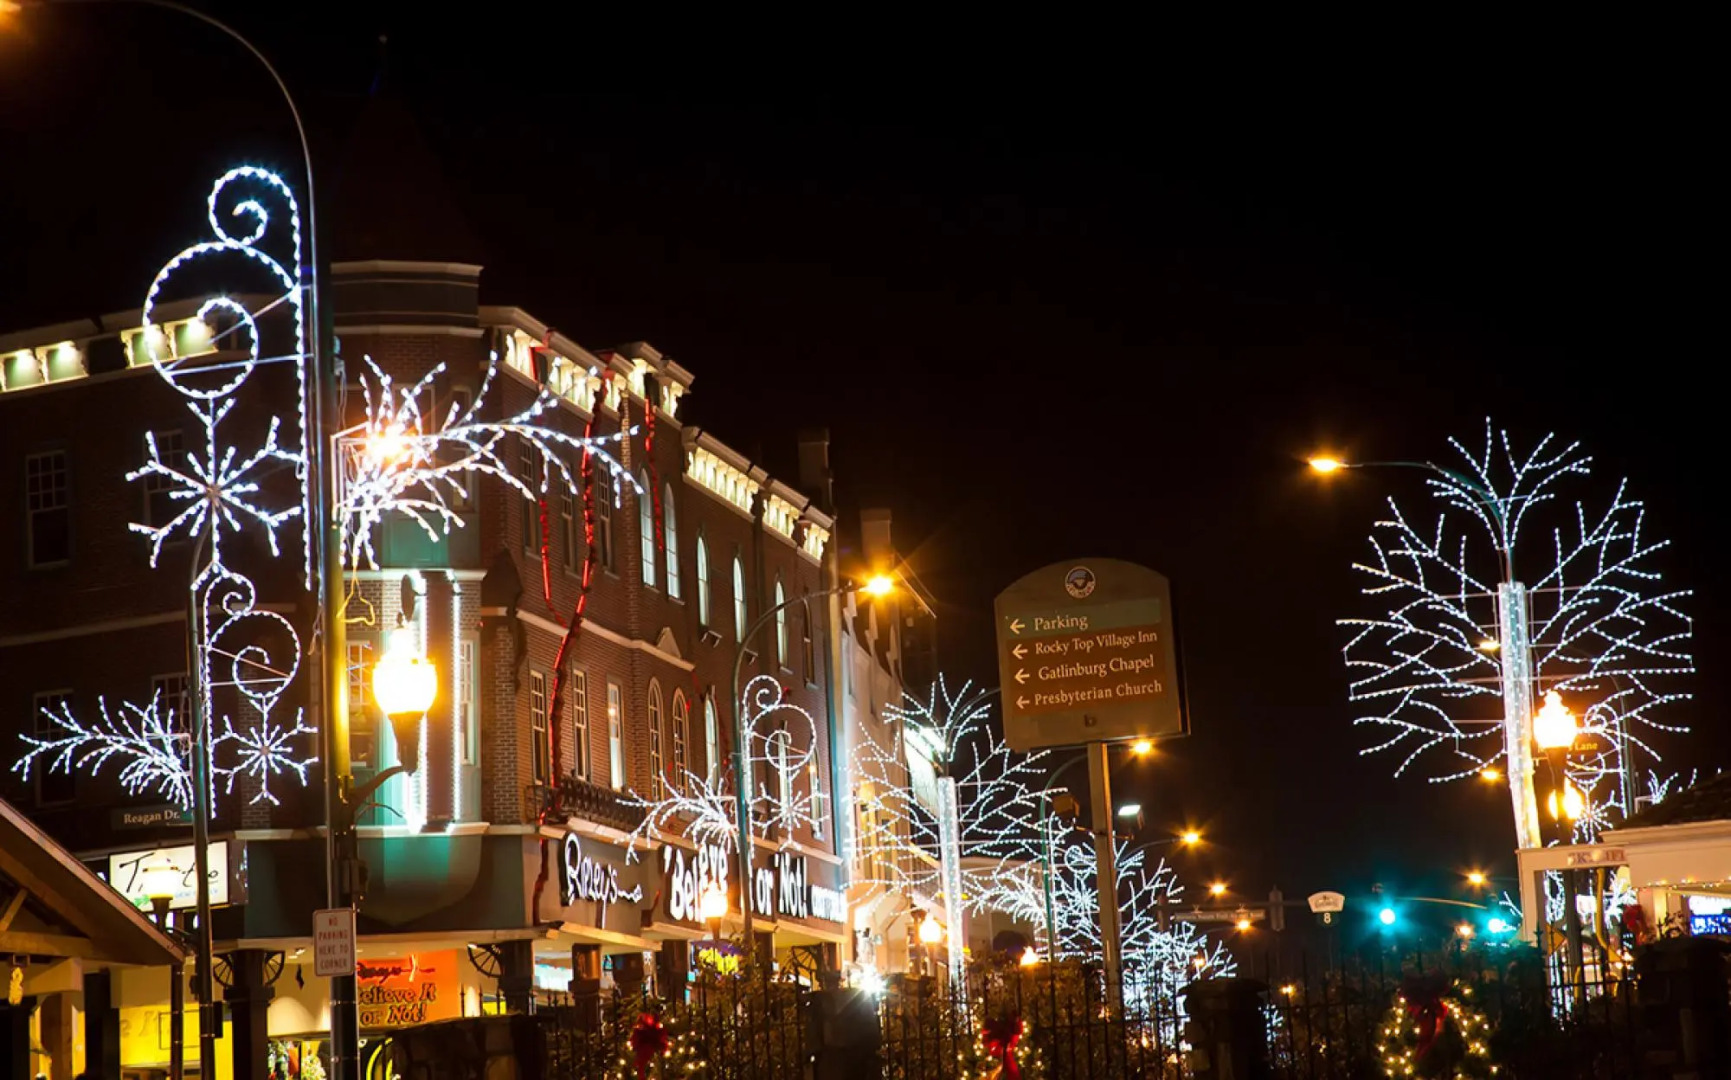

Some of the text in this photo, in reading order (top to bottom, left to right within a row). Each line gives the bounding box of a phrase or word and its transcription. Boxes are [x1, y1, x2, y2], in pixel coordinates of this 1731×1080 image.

[1034, 615, 1088, 631] Parking
[1035, 631, 1157, 655] Rocky Top Village Inn
[1038, 654, 1154, 680] Gatlinburg Chapel
[1034, 680, 1162, 706] Presbyterian Church
[1574, 741, 1598, 751] Lane
[124, 809, 180, 824] Reagan Dr.
[756, 867, 774, 917] or
[328, 917, 338, 927] NO
[1323, 912, 1331, 924] 8
[318, 930, 348, 941] PARKING
[319, 943, 349, 956] HERE TO
[319, 958, 348, 970] CORNER
[358, 983, 437, 1005] elieve It
[361, 1003, 427, 1026] or Not!
